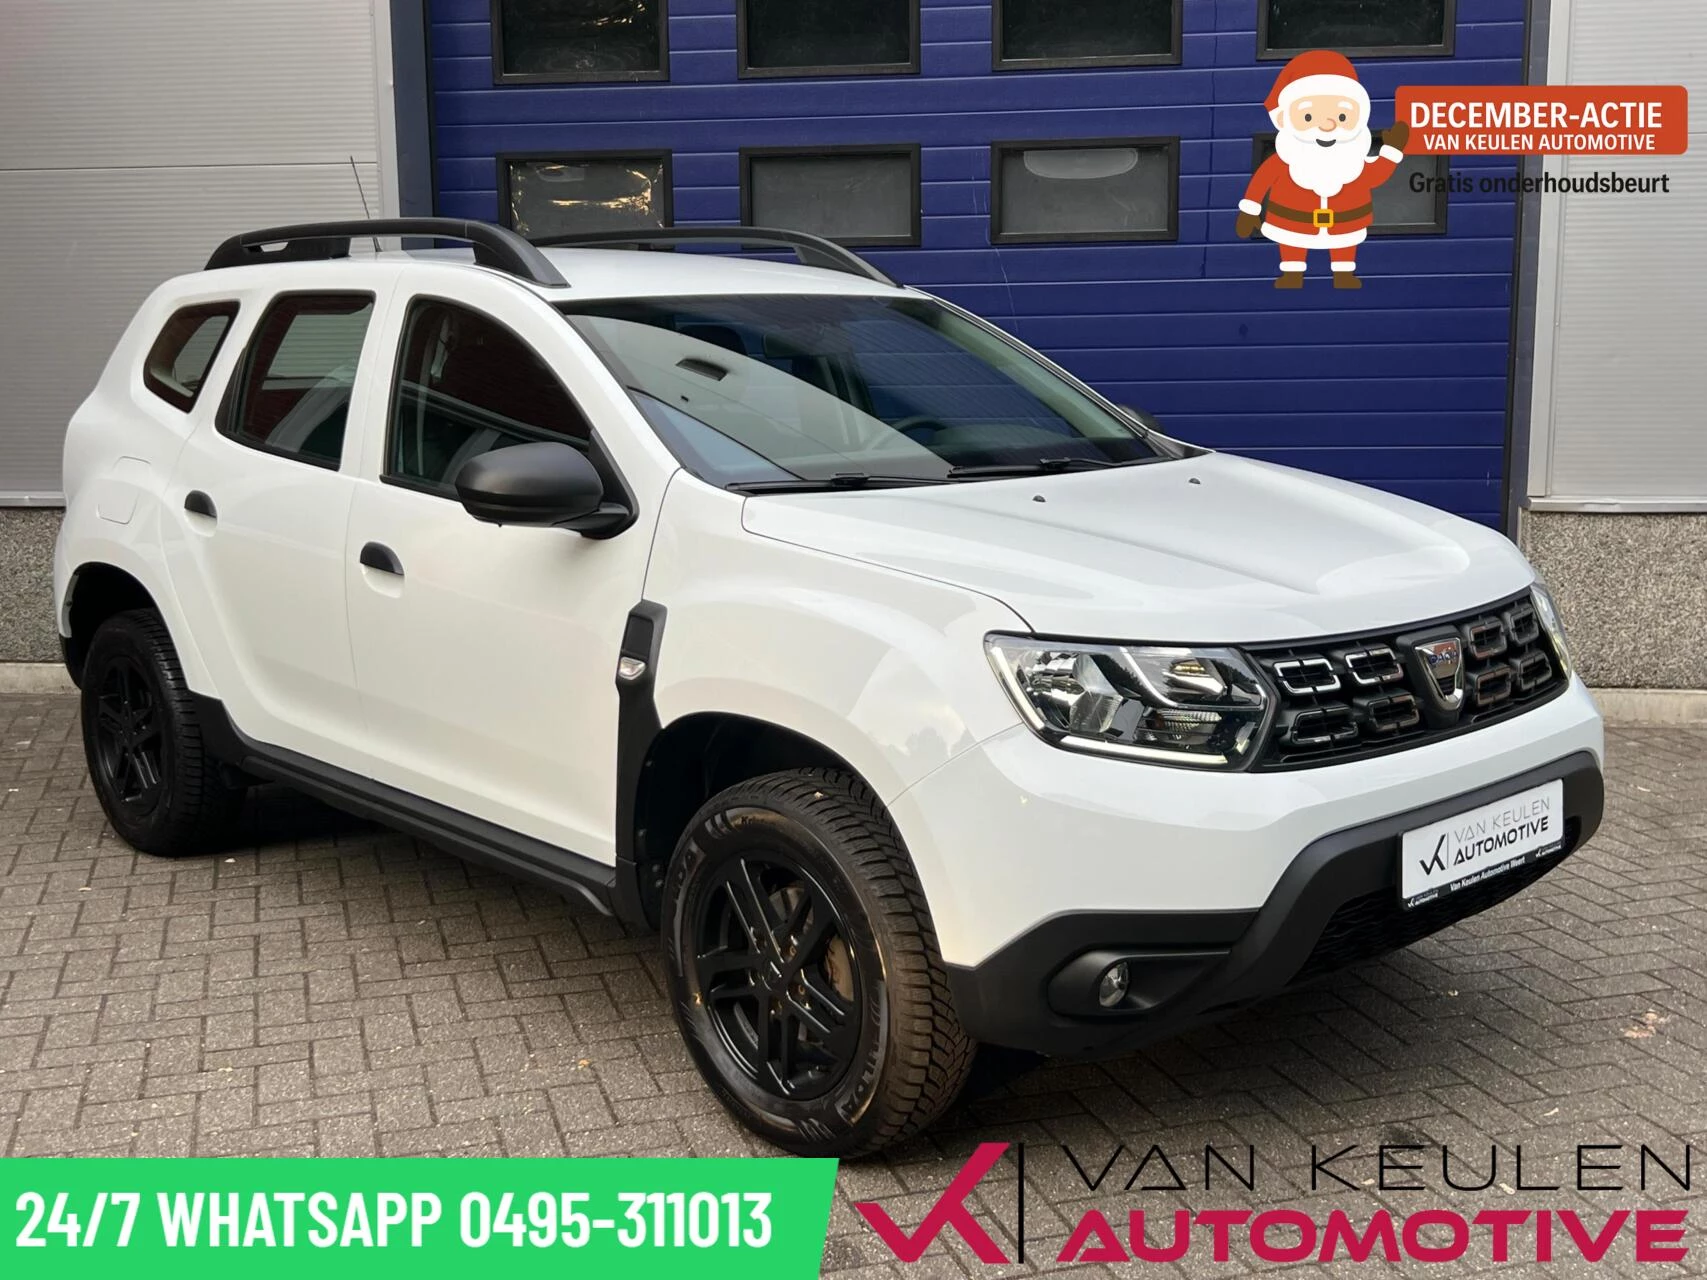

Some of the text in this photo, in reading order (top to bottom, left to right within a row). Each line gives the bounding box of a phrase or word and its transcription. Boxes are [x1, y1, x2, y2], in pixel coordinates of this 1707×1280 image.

[1453, 815, 1549, 866] AUTOMOTIVE
[1454, 796, 1550, 843] VAN KEULEN
